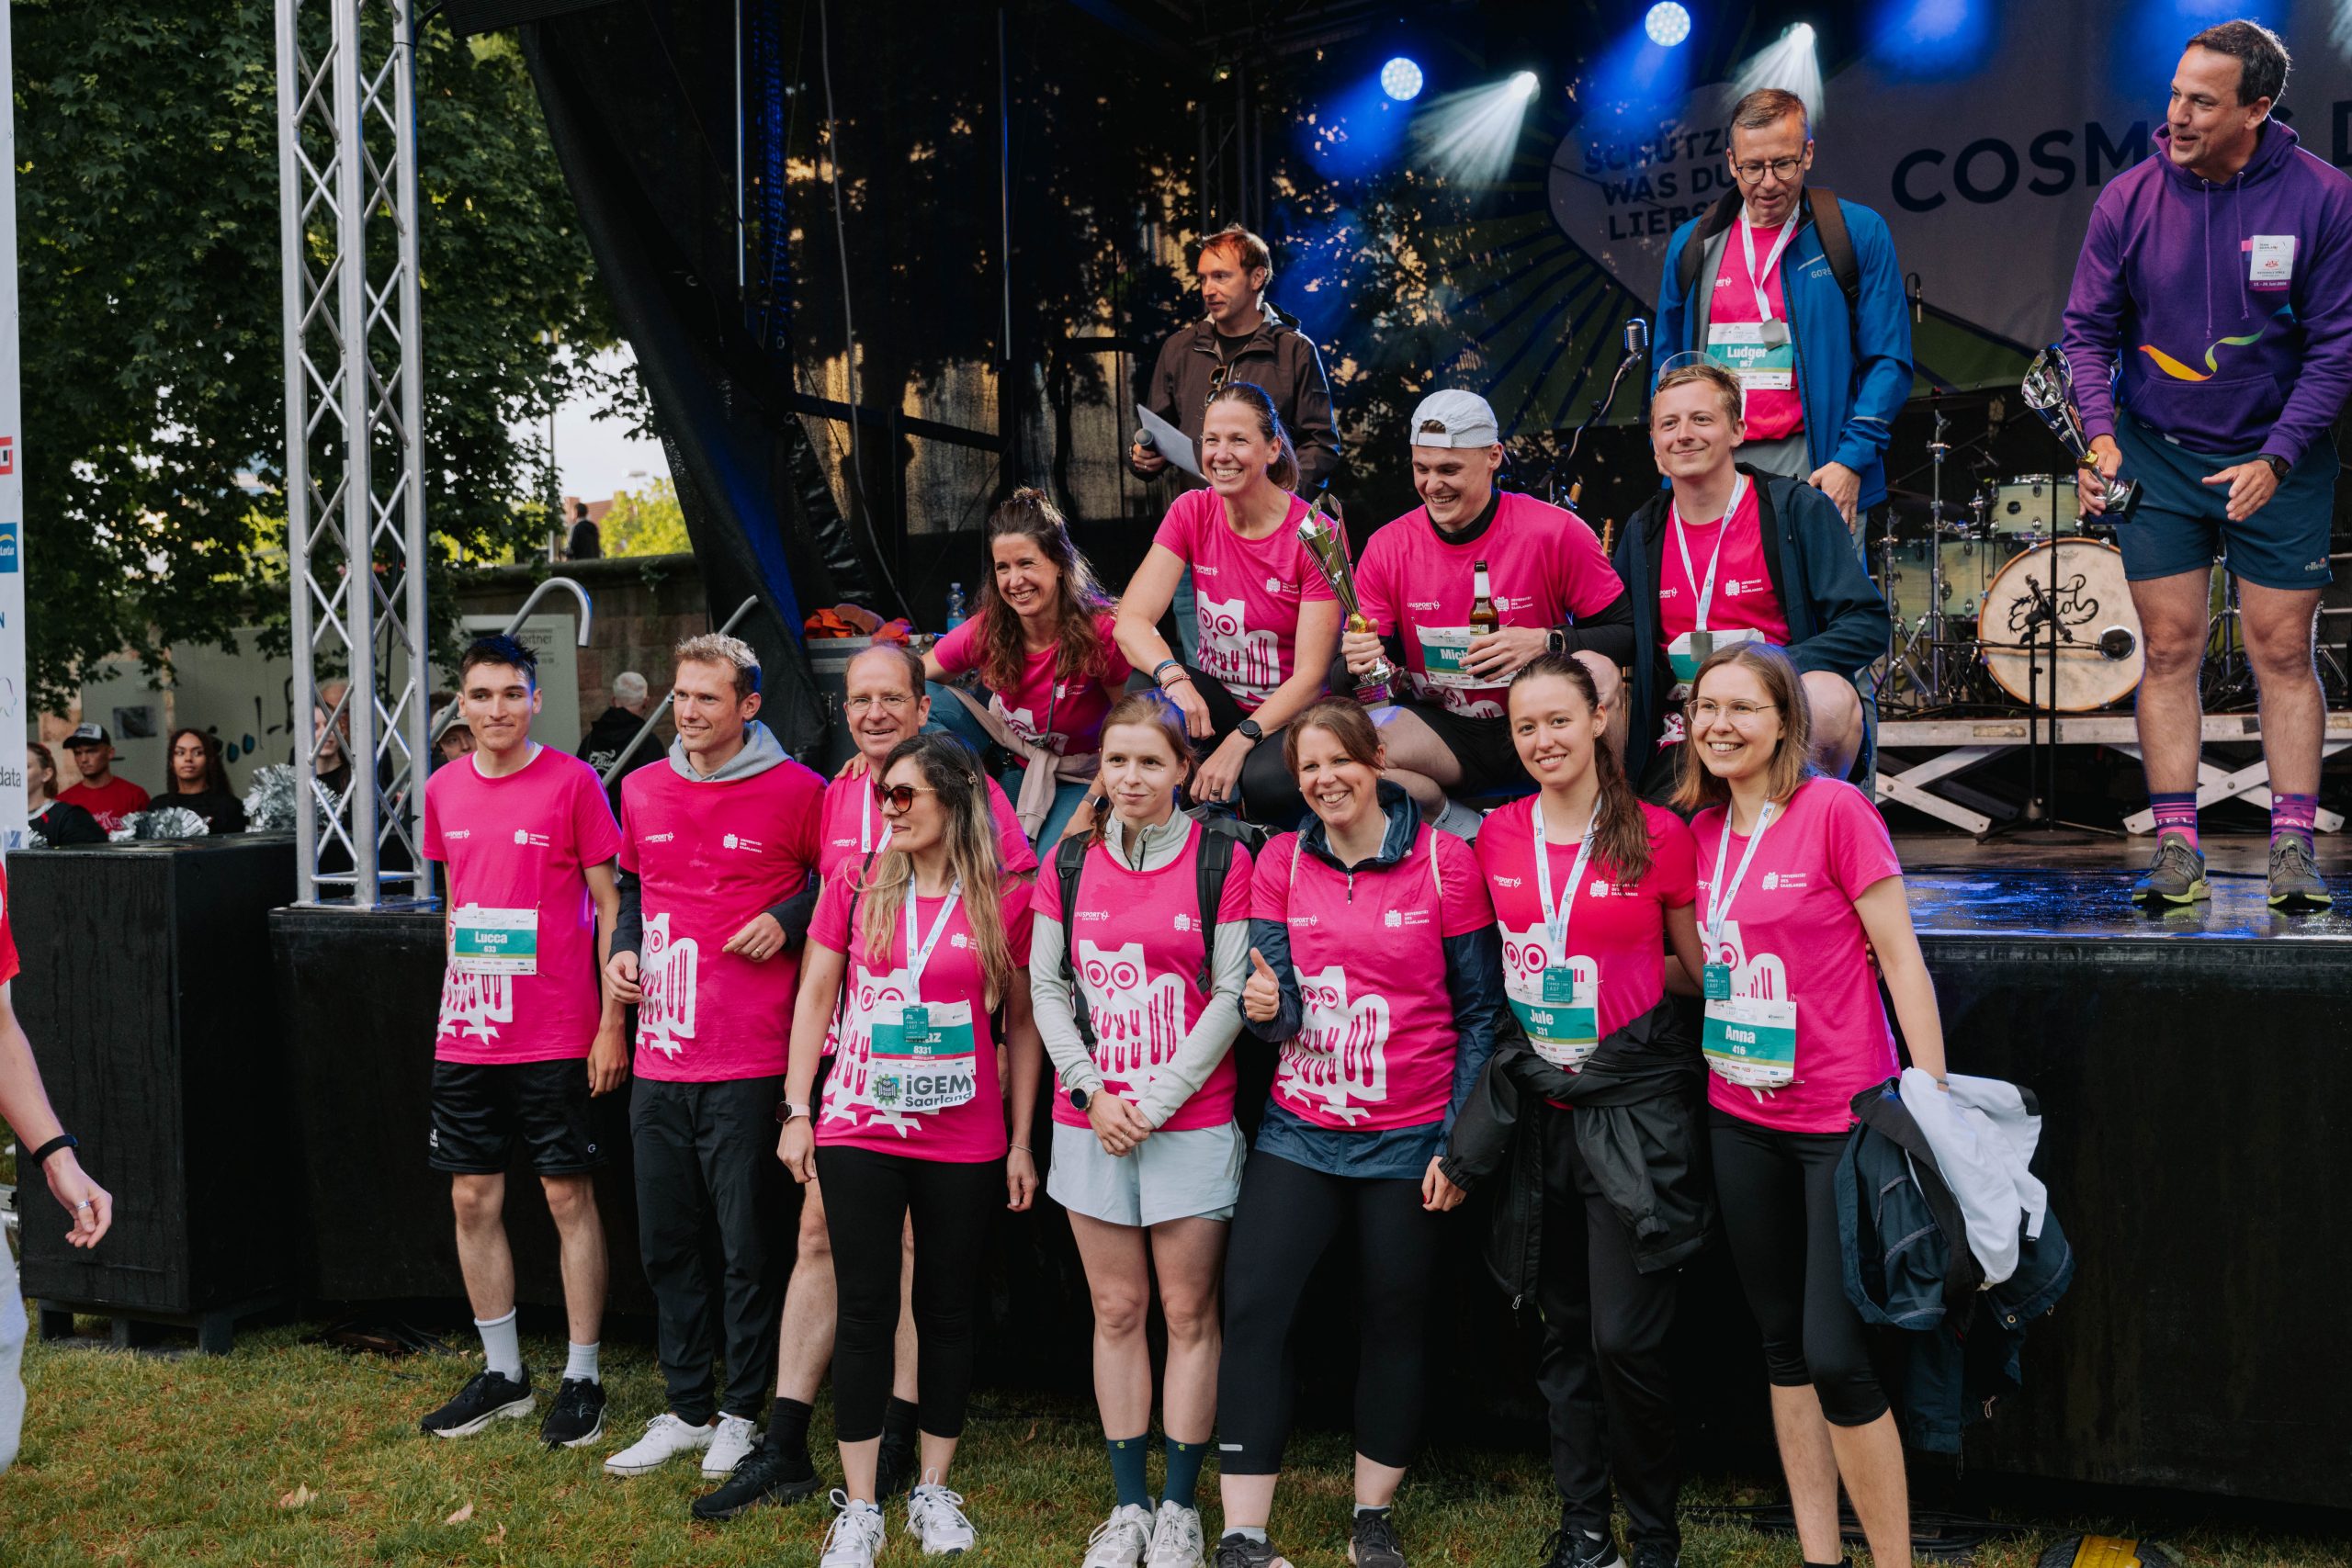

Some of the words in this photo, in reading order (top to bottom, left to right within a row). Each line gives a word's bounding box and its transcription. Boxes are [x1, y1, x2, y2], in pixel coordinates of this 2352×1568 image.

[1601, 173, 1678, 206] WAS
[1691, 164, 1736, 194] DU
[1727, 346, 1767, 360] Ludger
[474, 931, 507, 944] Lucca
[1530, 1009, 1555, 1025] Jule
[1725, 1025, 1756, 1043] Anna
[1732, 1044, 1746, 1055] 416
[906, 1074, 972, 1095] iGEM
[905, 1091, 972, 1108] Saarland
